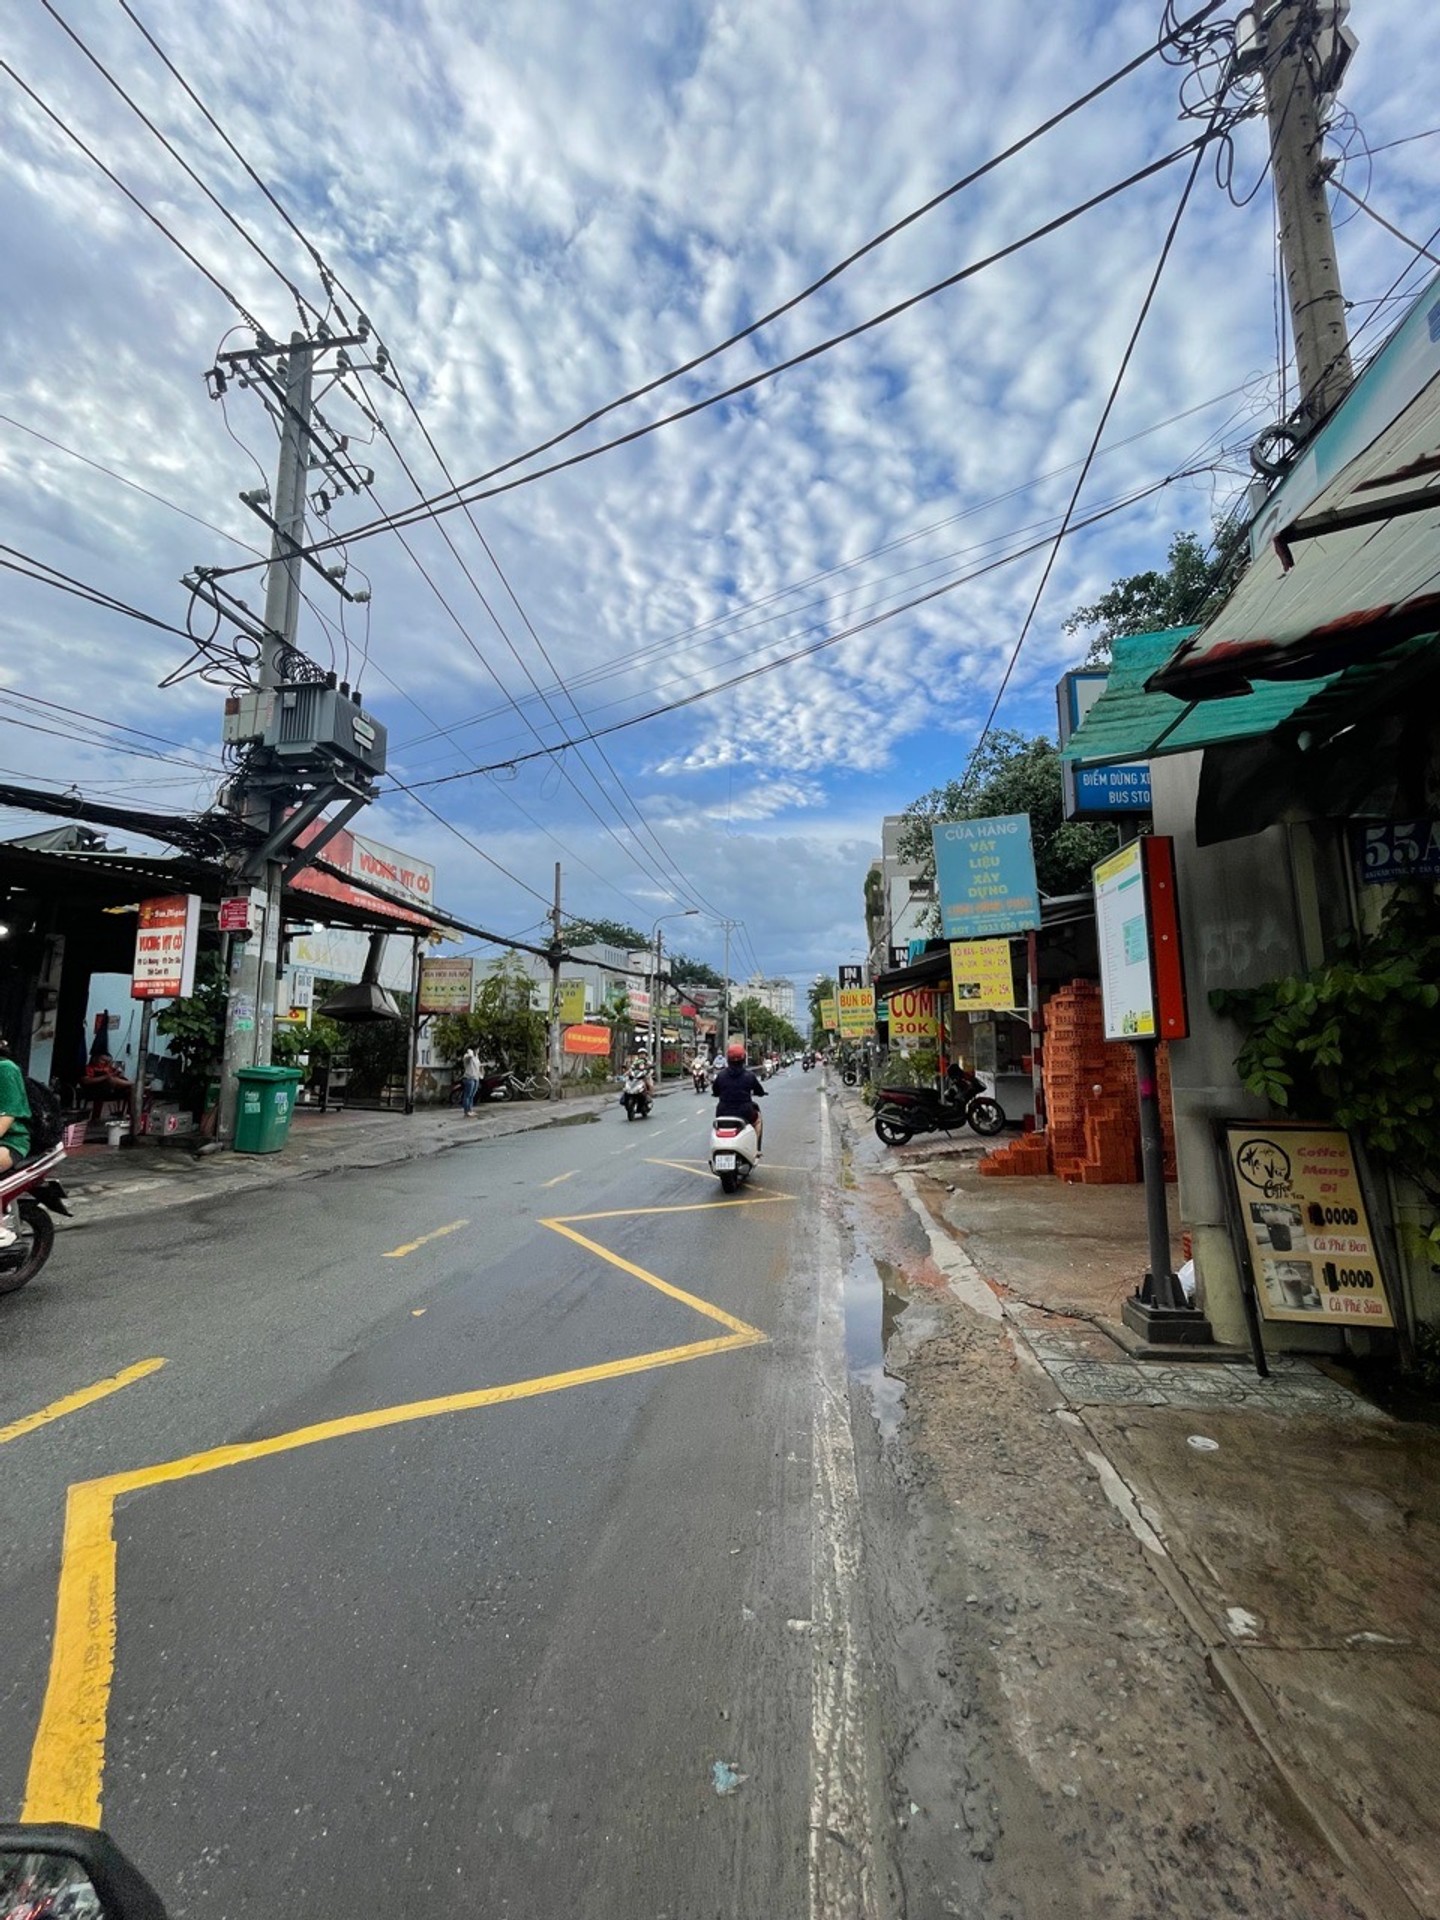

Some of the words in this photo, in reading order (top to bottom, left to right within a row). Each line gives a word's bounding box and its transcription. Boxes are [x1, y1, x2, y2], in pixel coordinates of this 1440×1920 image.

[1083, 769, 1107, 786] ĐIỂM
[1110, 770, 1138, 786] DỪNG
[1109, 791, 1130, 804] BUS
[1132, 791, 1151, 804] STO
[977, 821, 1018, 837] HÀNG
[895, 949, 908, 961] IN
[844, 967, 857, 979] IN
[895, 1022, 929, 1034] 30K
[1296, 1146, 1347, 1158] Coffee
[1302, 1164, 1350, 1178] Mang
[1313, 1237, 1326, 1251] Cà
[1328, 1239, 1345, 1252] Phê
[1349, 1239, 1367, 1253] Đen
[1329, 1296, 1342, 1312] Cà
[1343, 1299, 1360, 1314] Phê
[1363, 1299, 1383, 1315] Sữa
